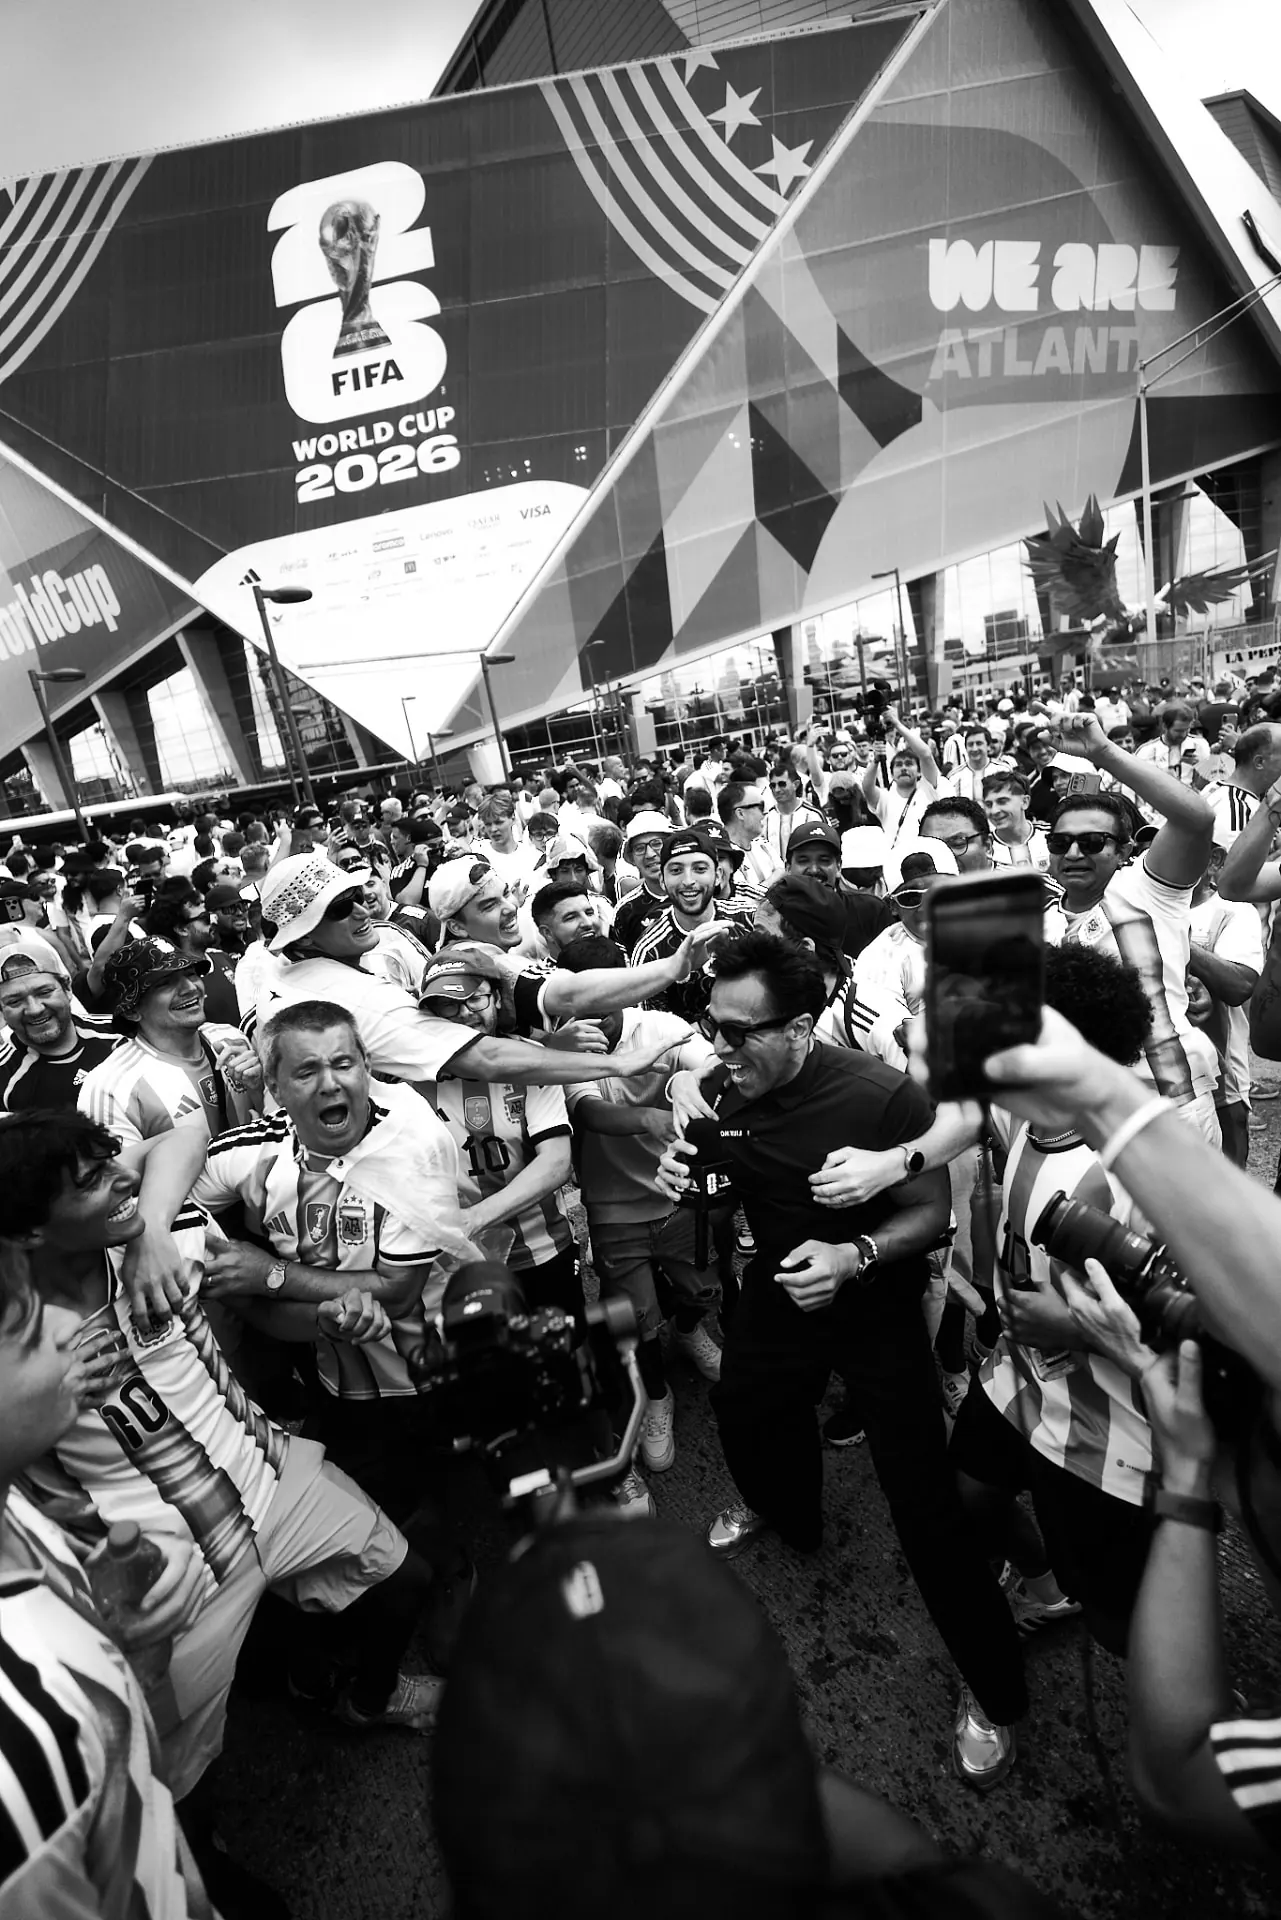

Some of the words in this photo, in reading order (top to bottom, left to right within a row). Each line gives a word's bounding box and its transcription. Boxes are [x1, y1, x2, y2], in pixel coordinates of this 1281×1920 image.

[929, 238, 1041, 311] WE
[331, 358, 404, 396] FIFA
[292, 421, 394, 462] WORLD
[398, 405, 455, 437] CUP
[295, 434, 460, 503] 2026
[519, 504, 551, 520] VISA
[0, 564, 121, 661] orldCup
[1225, 651, 1244, 663] LA
[462, 1135, 510, 1177] 10
[101, 1375, 170, 1449] 10
